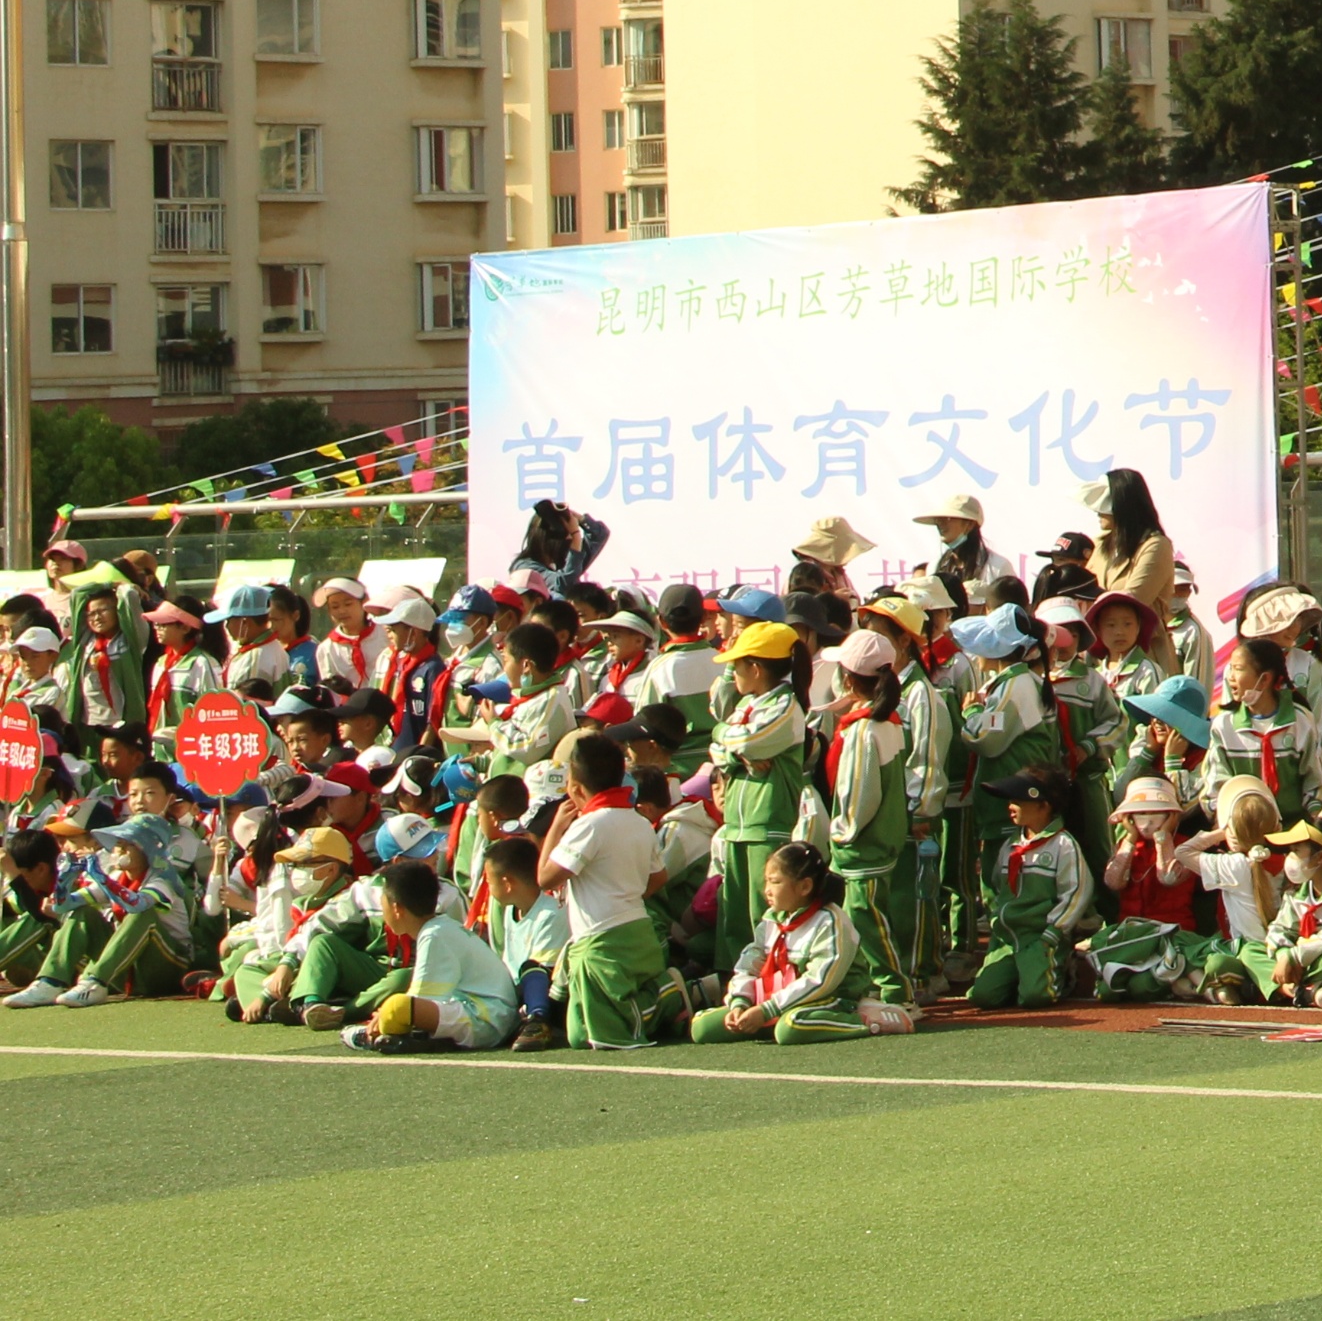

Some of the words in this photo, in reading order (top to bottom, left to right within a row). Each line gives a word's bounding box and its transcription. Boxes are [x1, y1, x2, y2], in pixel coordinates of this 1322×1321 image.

[596, 244, 1138, 336] 昆明市西山区芳草地国际学校
[502, 377, 1233, 510] 首届体育文化节
[183, 733, 260, 761] 二年级3班
